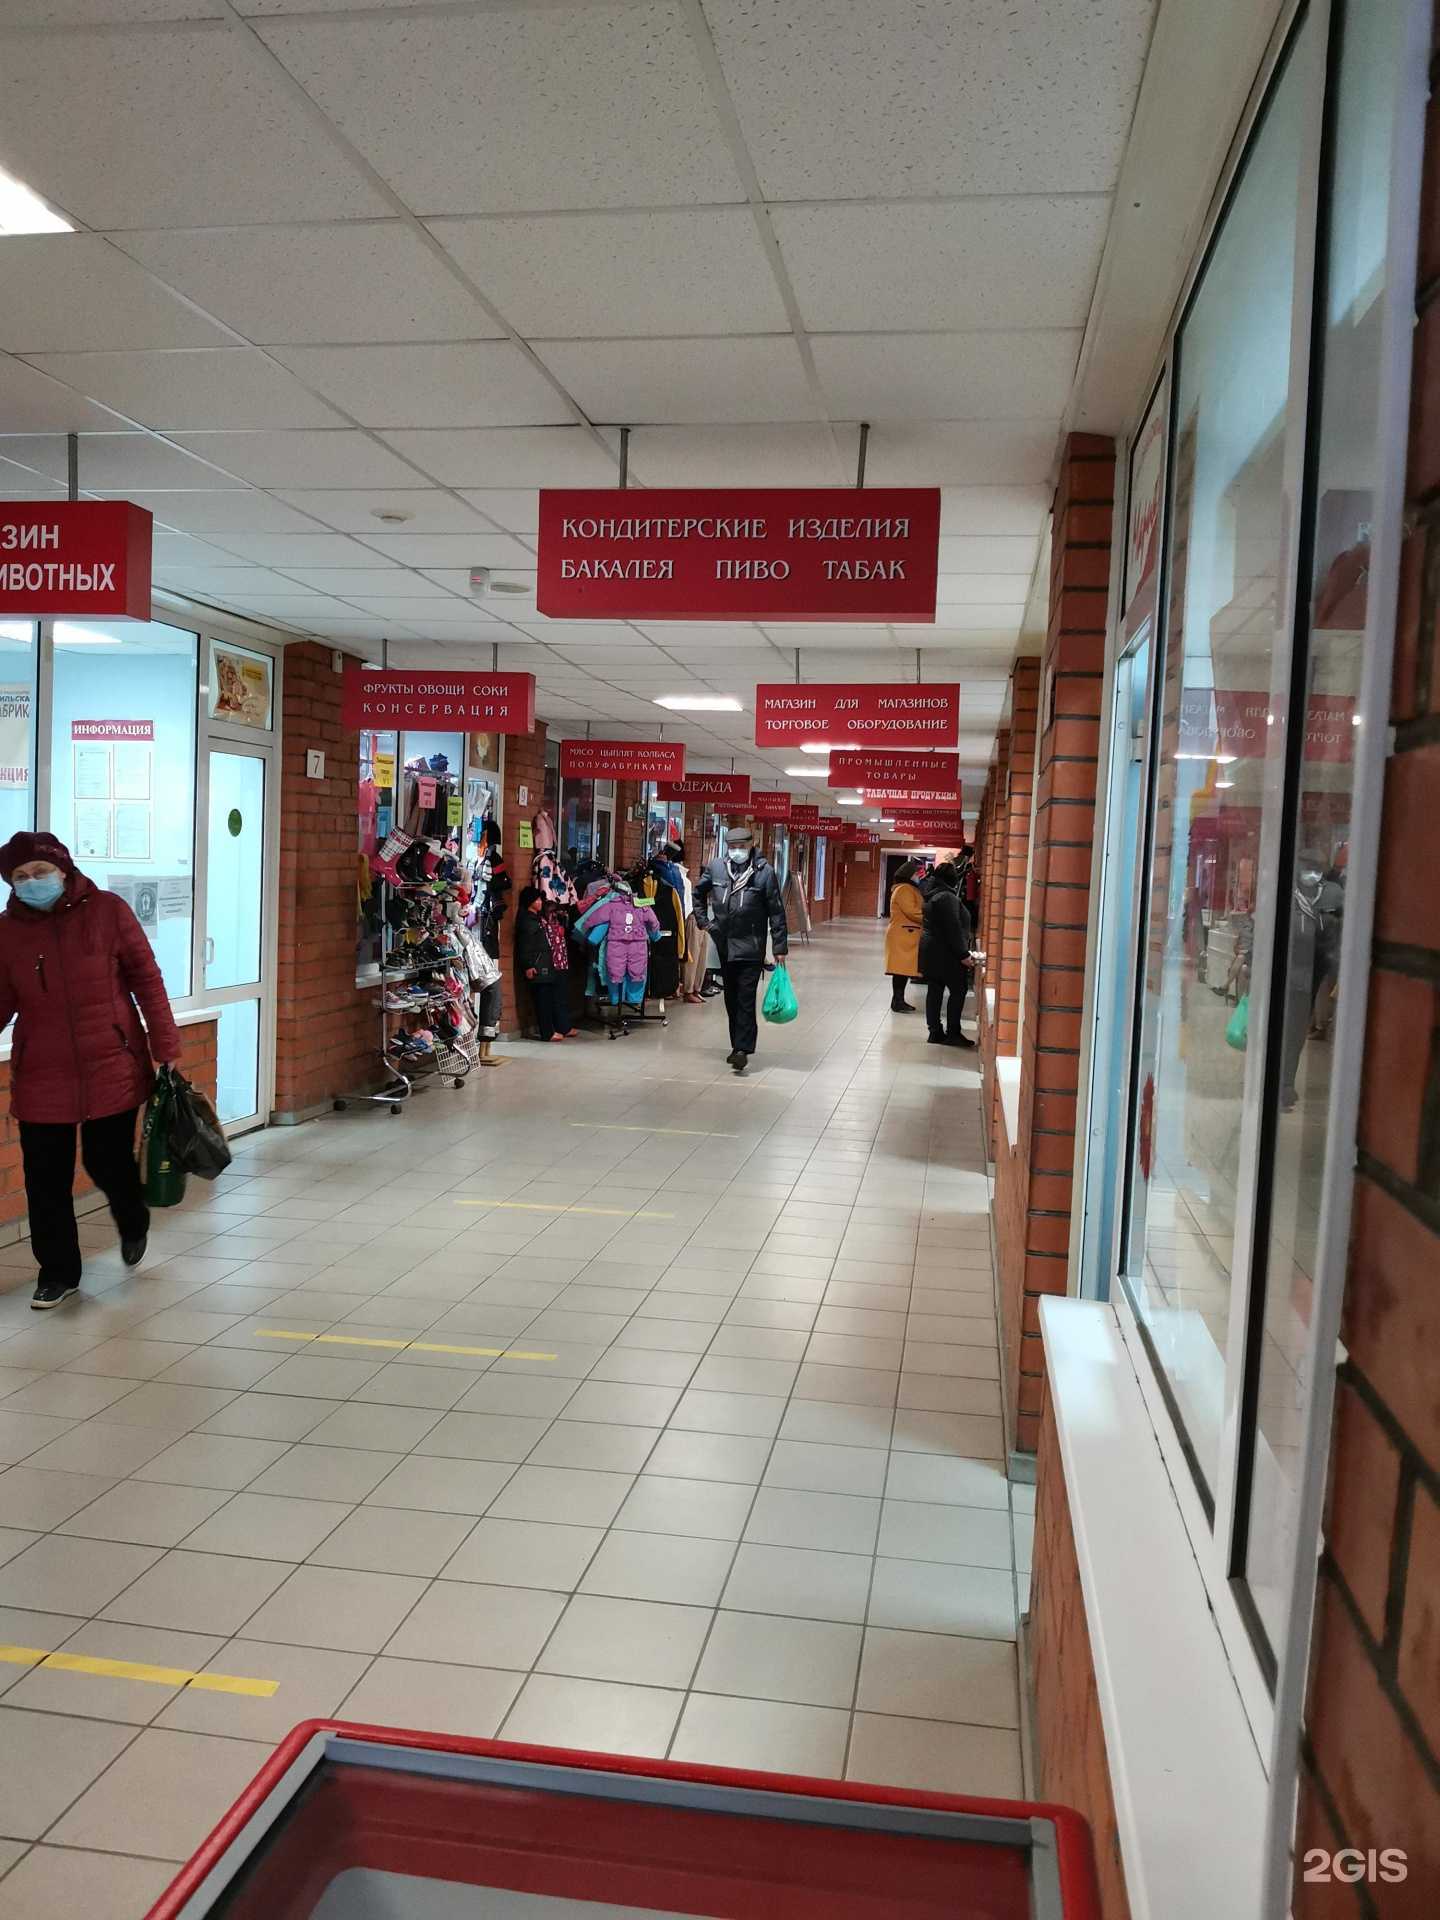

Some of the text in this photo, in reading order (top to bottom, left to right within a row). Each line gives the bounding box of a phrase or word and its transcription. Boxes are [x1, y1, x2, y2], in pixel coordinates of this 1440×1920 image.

[561, 518, 911, 541] КОНДИТЕРСКИЕ ИЗДЕЛИЯ
[0, 524, 60, 550] ЗИН
[560, 559, 906, 581] БАКАЛЕЯ ПИВО ТАБАК
[363, 683, 509, 697] ФРУКТЫ ОВОЩИ СОКИ
[363, 702, 509, 717] КОНСЕРВАЦИЯ
[764, 698, 949, 710] МАГАЗИН ДЛЯ МАГАЗИНОВ
[0, 703, 30, 719] БРИК
[74, 724, 152, 736] ИНФОРМАЦИЯ
[765, 719, 949, 731] ТОРГОВОЕ ОБОРУДОВАНИЕ
[569, 747, 595, 757] МЯСО
[637, 750, 676, 760] КОЛБАСА
[313, 754, 321, 775] 7
[569, 760, 672, 772] ПОЛУФАБРИКАТЫ
[838, 756, 948, 768] ПРОМЫШЛЕННЫЕ
[866, 770, 917, 780] ТОВАРЫ
[671, 780, 733, 794] ОДЕЖДА
[866, 788, 958, 801] ТАБАЧНАЯ ПРОДУКЦИЯ
[922, 820, 958, 830] ОГОРОД
